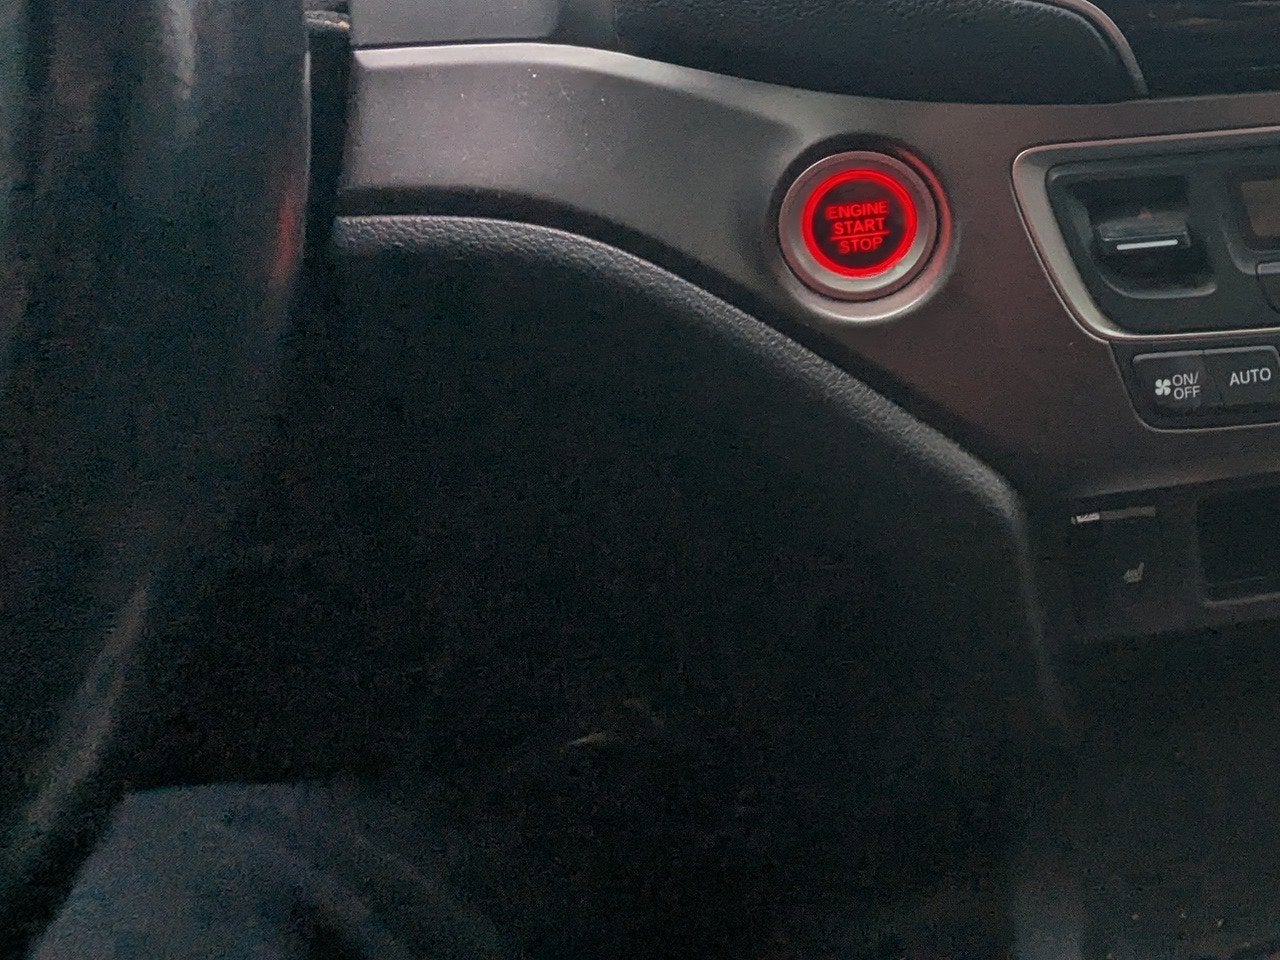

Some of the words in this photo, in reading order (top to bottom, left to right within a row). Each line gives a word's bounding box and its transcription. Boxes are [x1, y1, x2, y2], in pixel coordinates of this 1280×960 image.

[828, 200, 888, 219] ENGINE
[834, 218, 885, 234] START
[839, 236, 884, 254] STOP
[1229, 367, 1272, 386] AUTO
[1173, 385, 1201, 400] OFF
